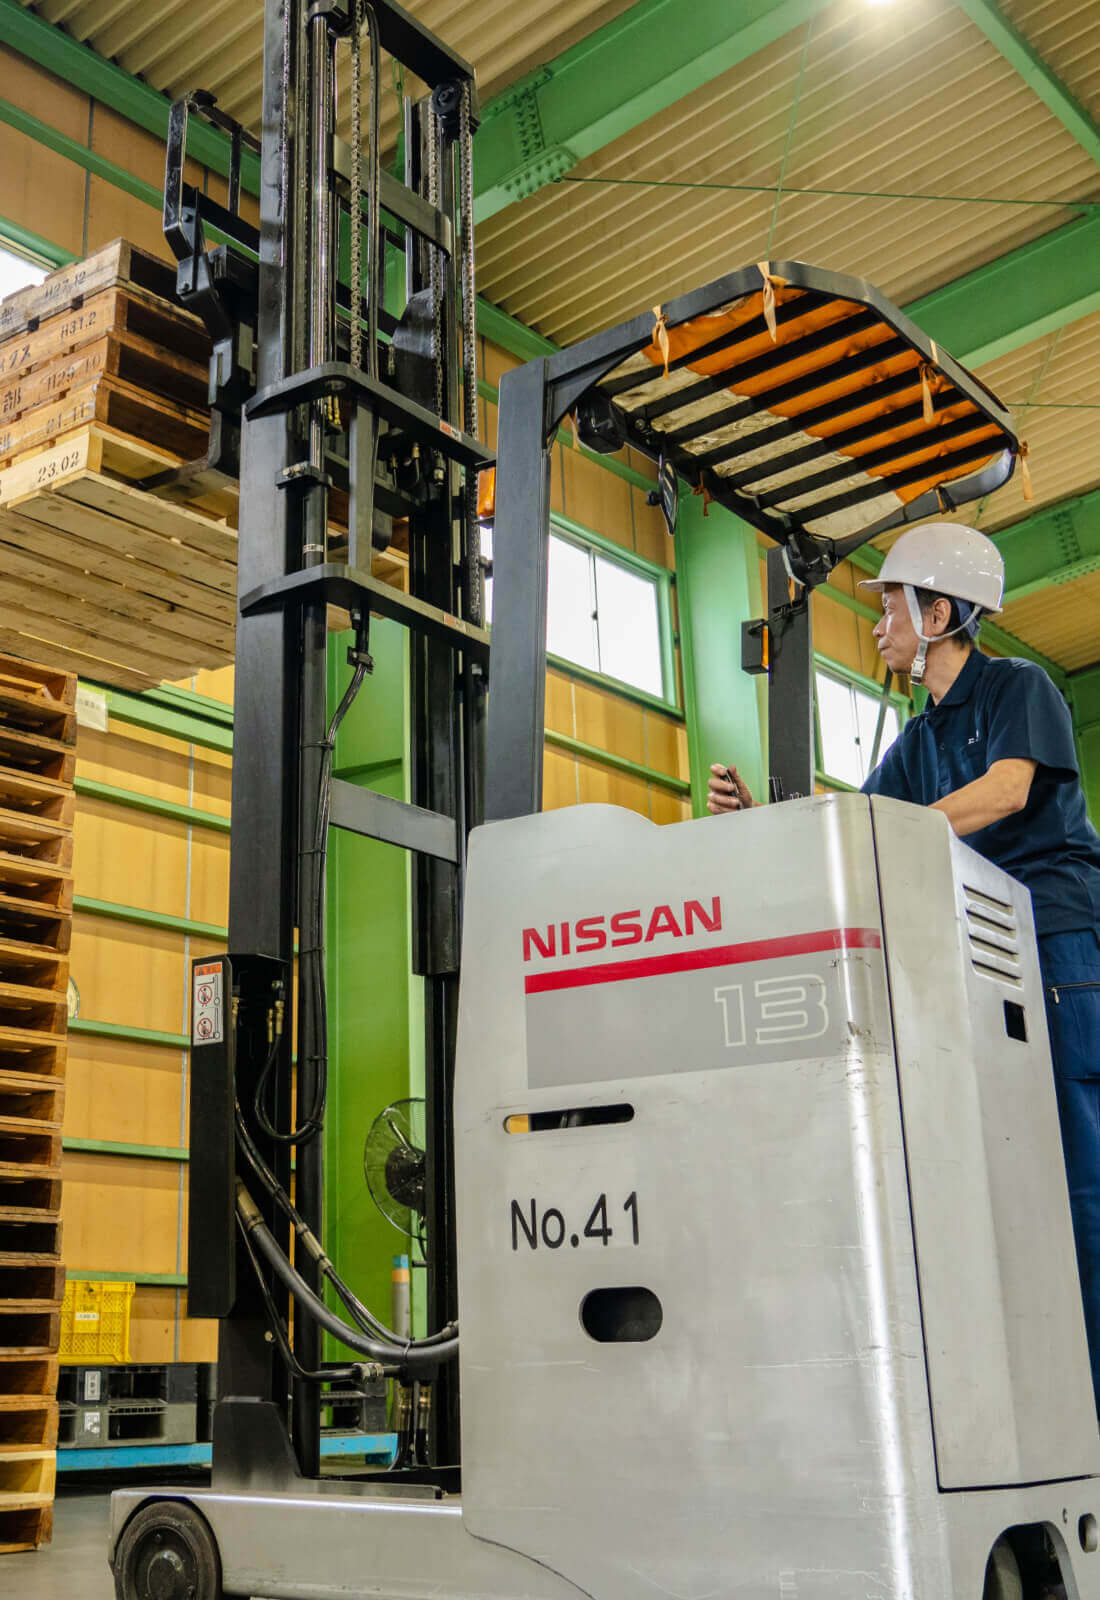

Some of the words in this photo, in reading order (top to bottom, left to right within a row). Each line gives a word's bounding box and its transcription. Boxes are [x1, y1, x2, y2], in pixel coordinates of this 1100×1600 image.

[37, 451, 79, 483] 23.02
[522, 896, 722, 961] NISSAN
[714, 973, 829, 1047] 13
